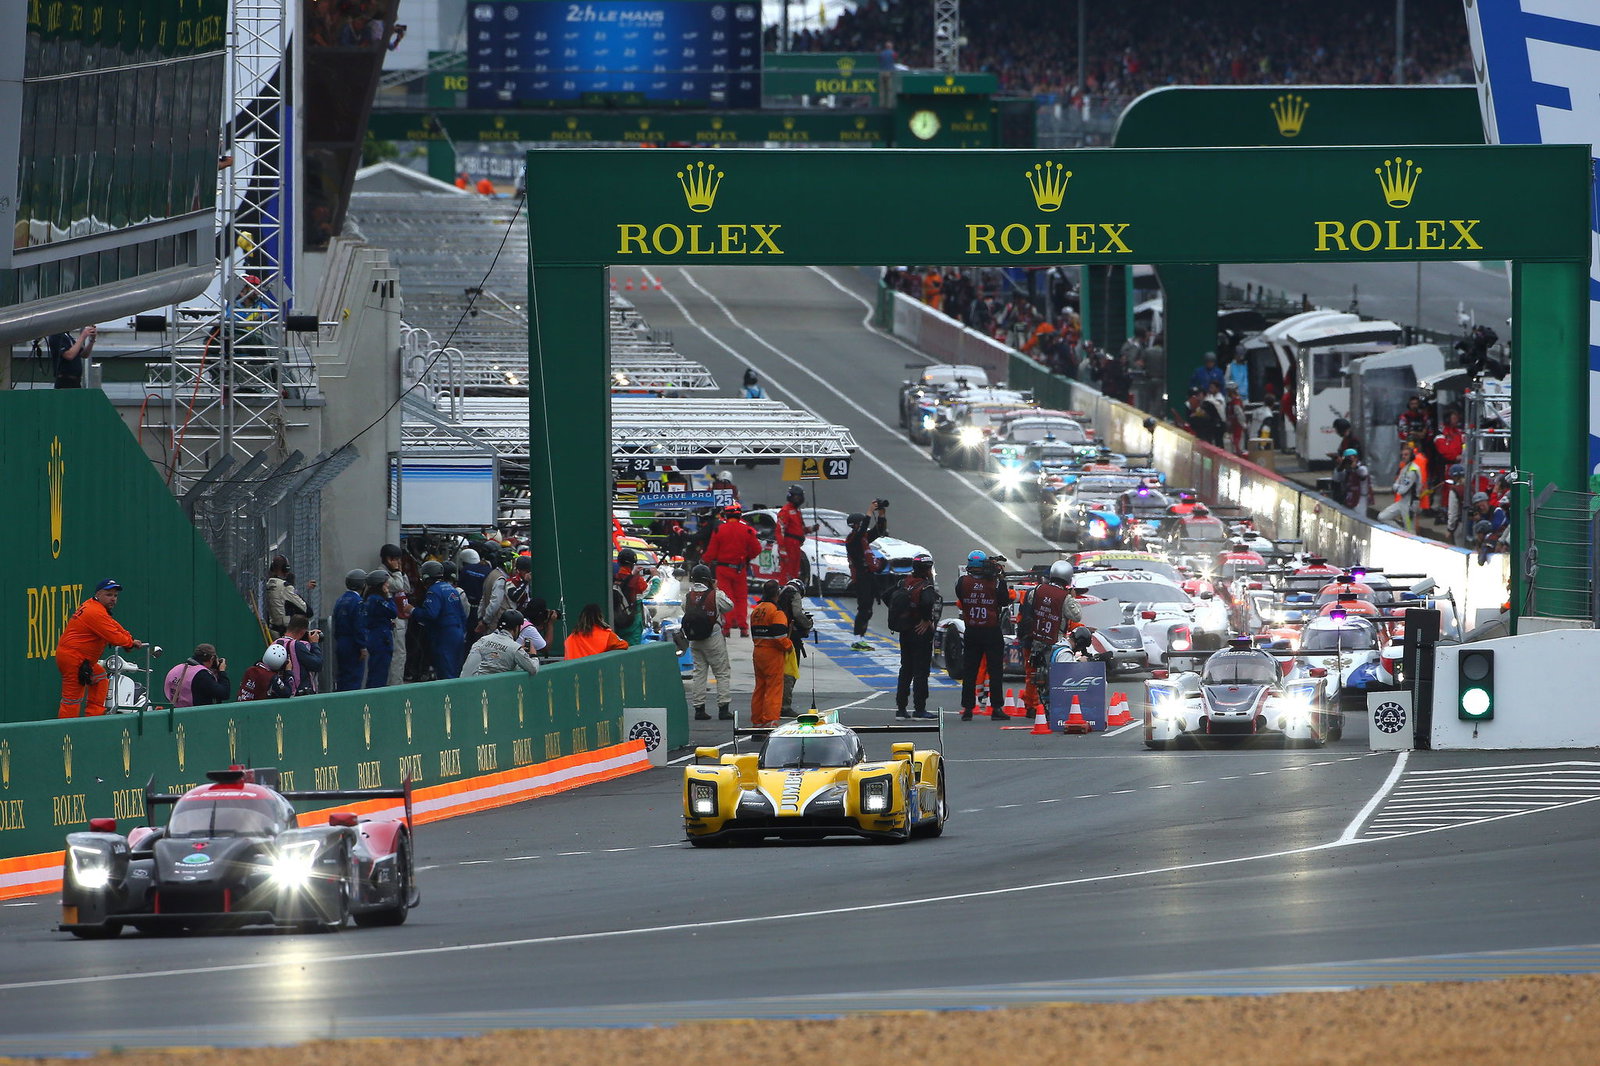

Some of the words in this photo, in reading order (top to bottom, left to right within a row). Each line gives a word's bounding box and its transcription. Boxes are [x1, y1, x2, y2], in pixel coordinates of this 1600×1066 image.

[620, 10, 665, 22] MANS
[815, 79, 876, 93] ROLEX
[617, 224, 784, 255] ROLEX
[966, 223, 1133, 255] ROLEX
[1315, 219, 1483, 252] ROLEX
[633, 459, 650, 471] 32
[829, 460, 848, 476] 29
[640, 492, 687, 500] ALGARVE
[716, 494, 733, 507] 25
[969, 606, 987, 619] 479
[1036, 619, 1052, 634] 19
[484, 640, 508, 652] OFFICIAL
[1062, 676, 1103, 686] WEC
[399, 753, 423, 784] ROLEX
[440, 748, 461, 777] ROLEX
[476, 743, 498, 772] ROLEX
[314, 765, 339, 791] ROLEX
[357, 760, 382, 790] ROLEX
[0, 799, 26, 831] OLEX
[53, 794, 88, 826] ROLEX
[112, 788, 145, 820] ROLEX
